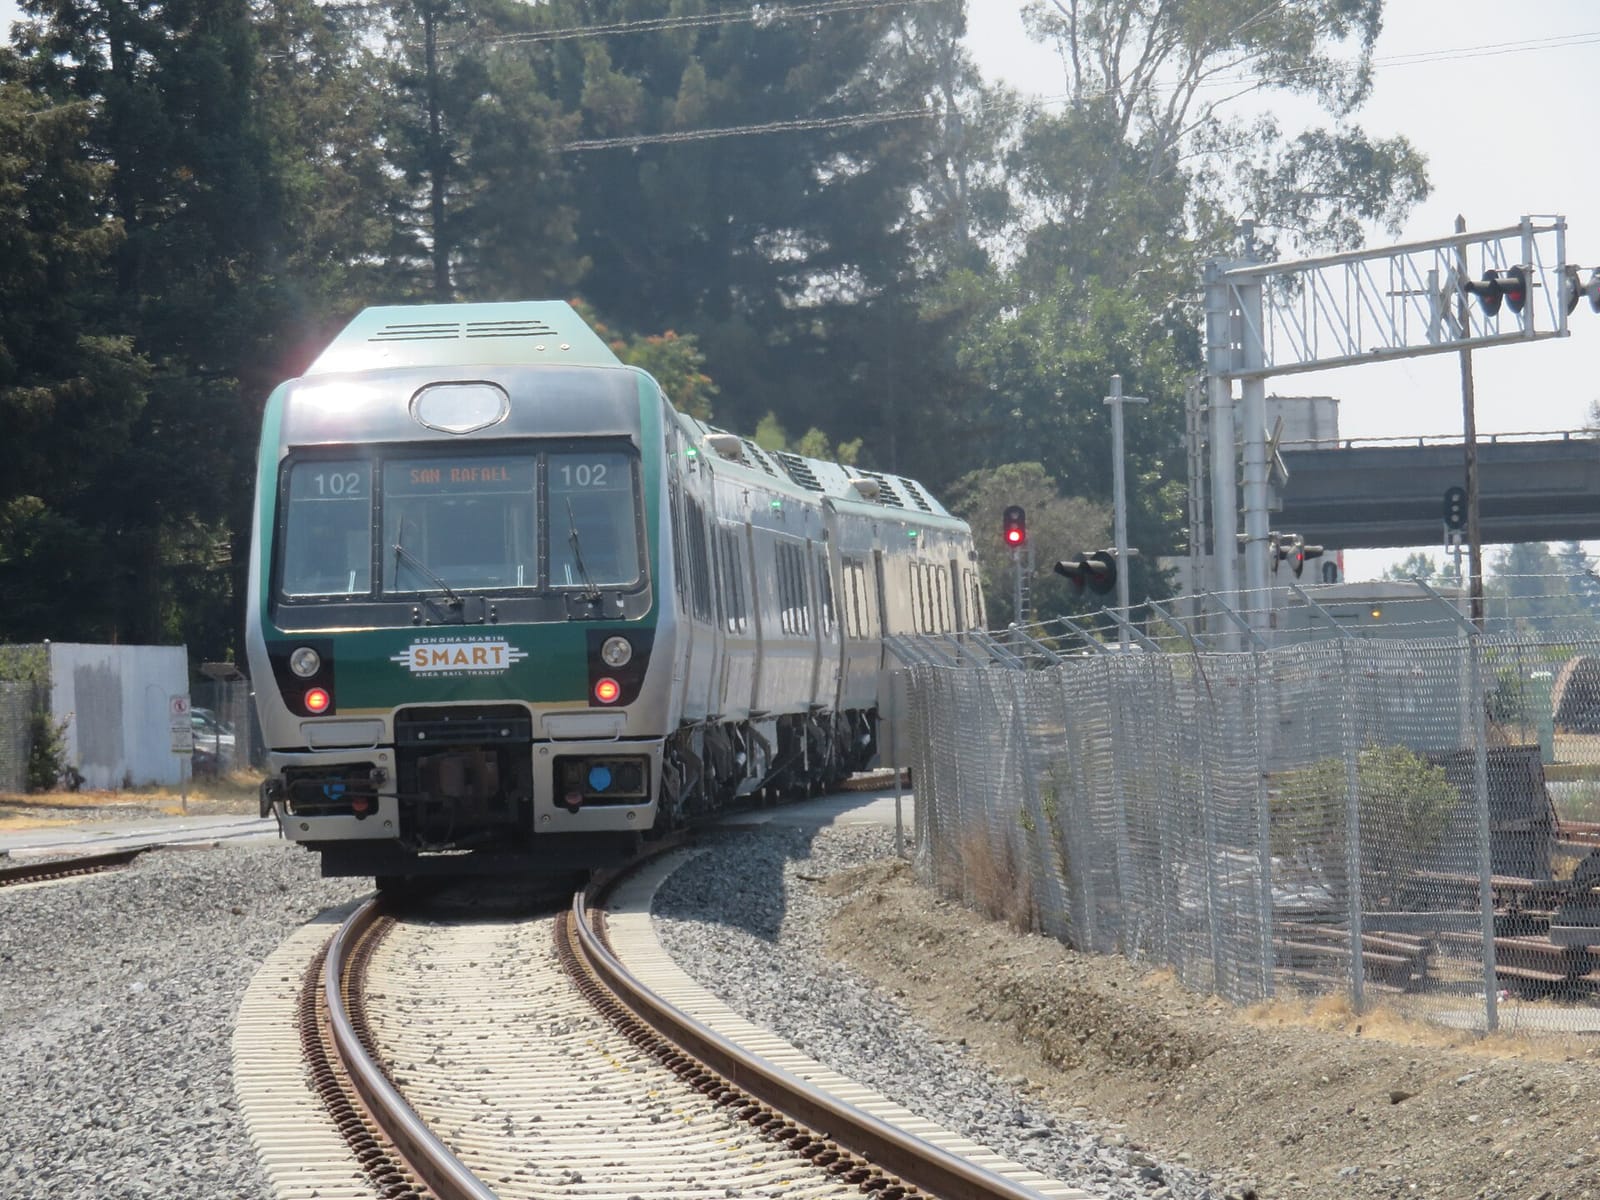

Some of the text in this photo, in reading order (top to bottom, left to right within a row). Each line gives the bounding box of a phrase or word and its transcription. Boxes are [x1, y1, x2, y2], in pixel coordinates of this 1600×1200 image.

[314, 473, 361, 495] 102
[410, 466, 511, 485] SAN RAFAEL
[561, 464, 607, 487] 102
[414, 646, 505, 667] SMART
